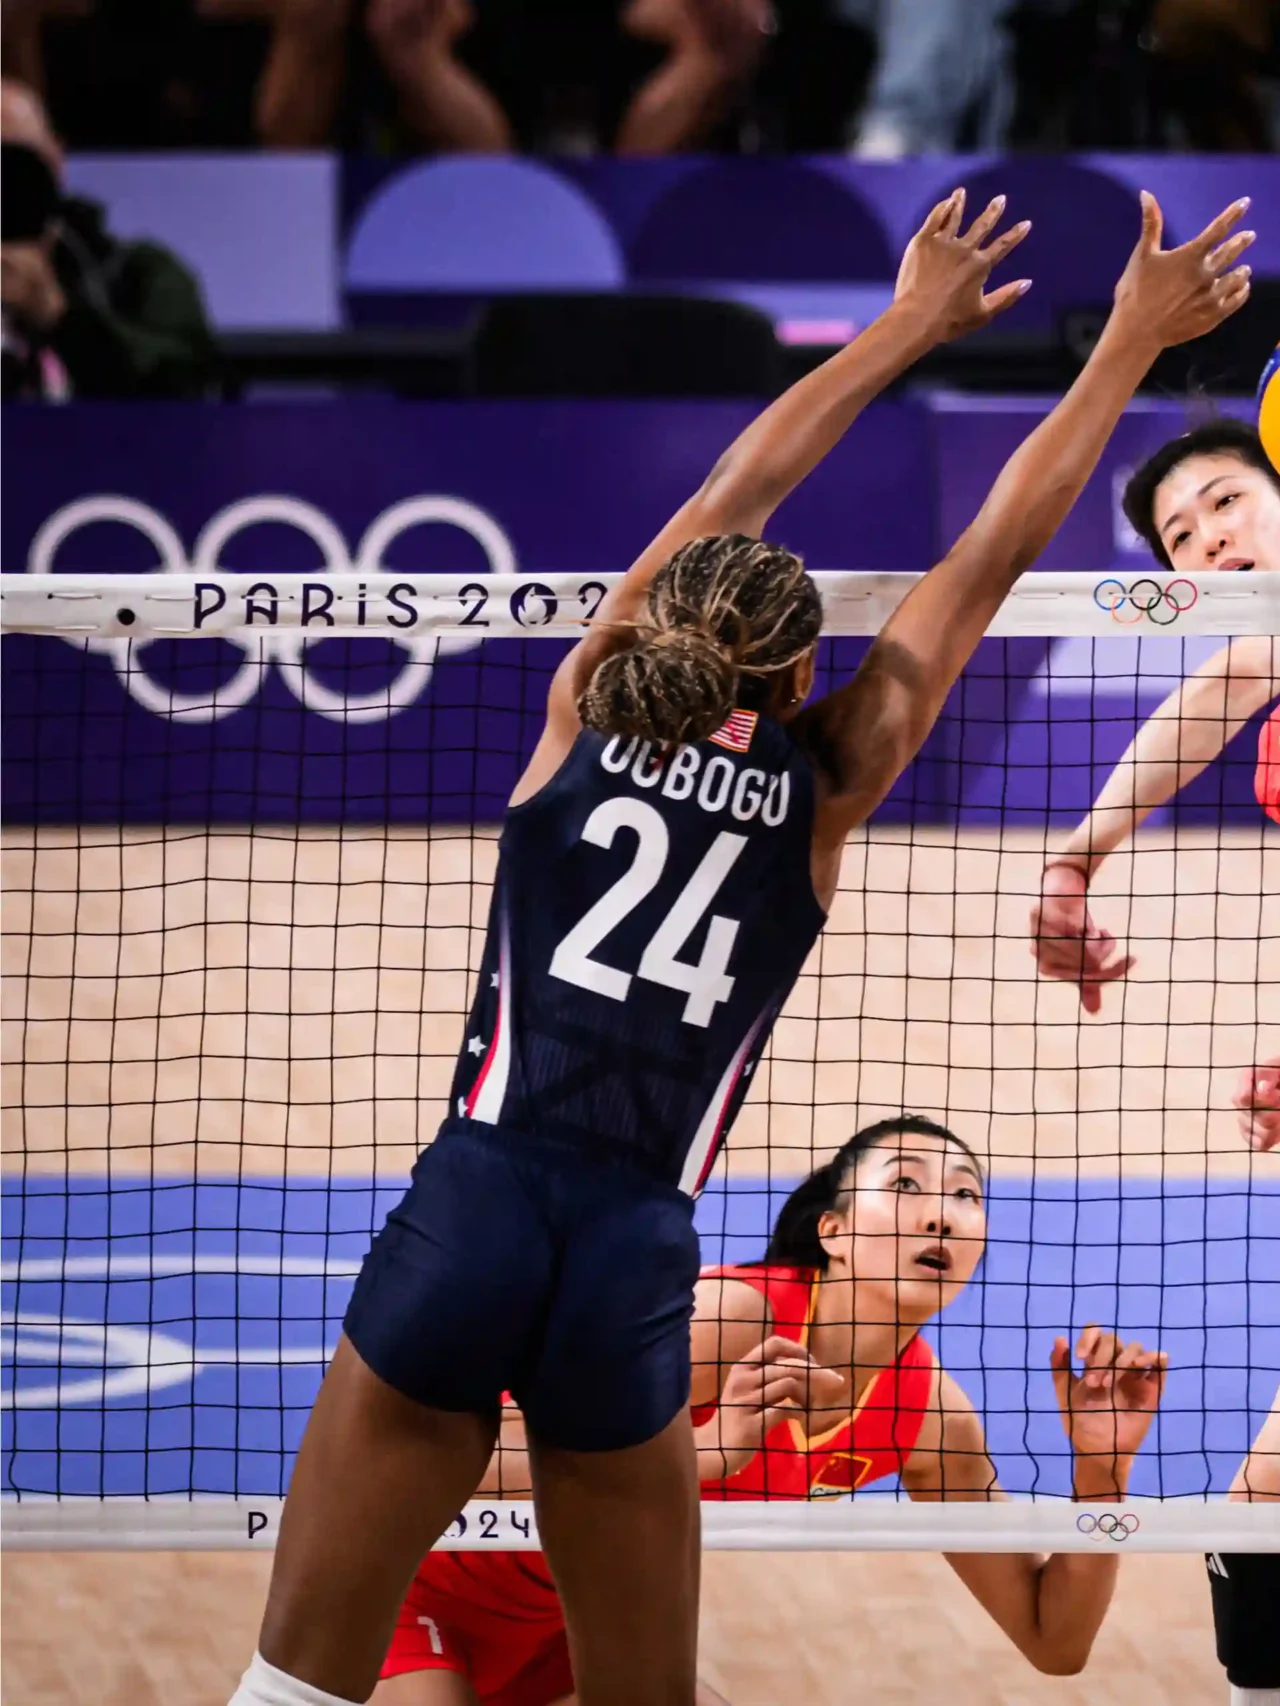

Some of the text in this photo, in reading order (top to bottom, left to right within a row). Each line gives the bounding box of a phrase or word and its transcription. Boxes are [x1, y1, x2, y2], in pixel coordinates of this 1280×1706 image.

[457, 581, 608, 628] 202
[600, 733, 790, 828] OGBOGU
[548, 797, 749, 1029] 24
[442, 1510, 530, 1539] 024
